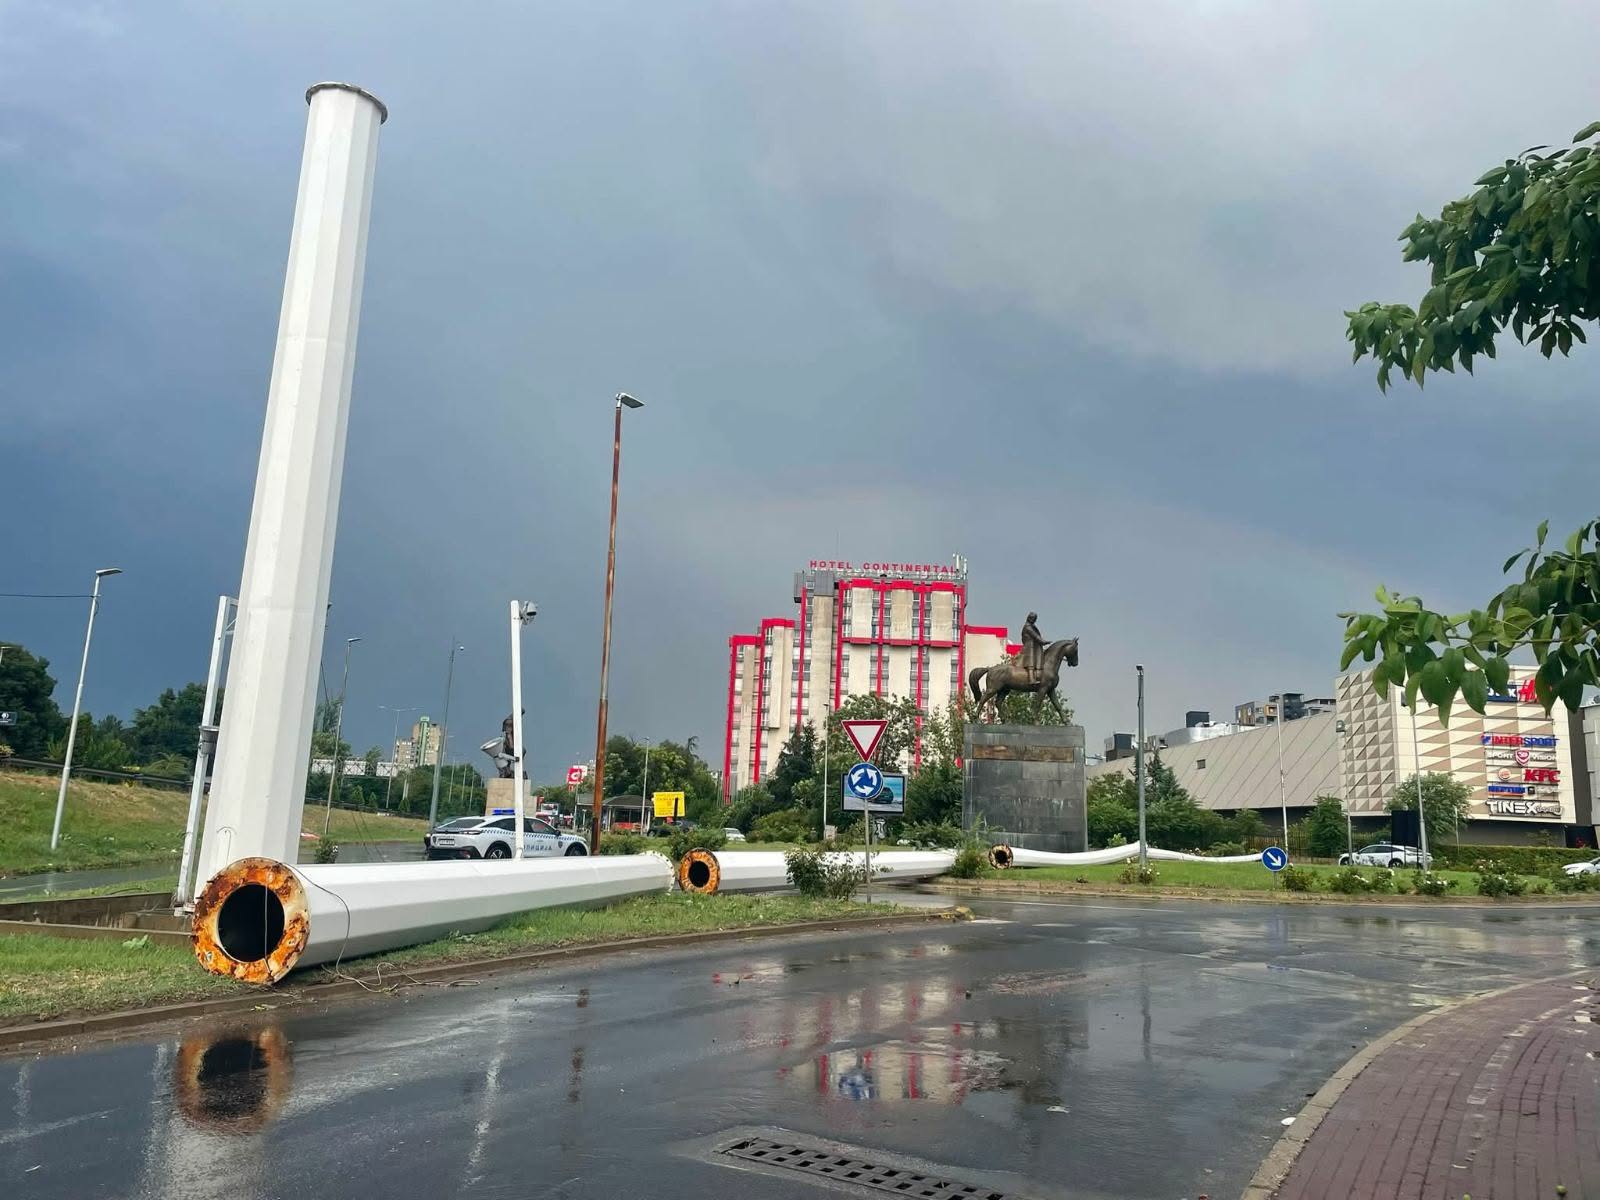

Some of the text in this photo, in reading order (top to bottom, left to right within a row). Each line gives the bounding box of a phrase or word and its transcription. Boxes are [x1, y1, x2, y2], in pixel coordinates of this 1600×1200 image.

[810, 560, 957, 574] HOTEL CONTINENTAL
[1493, 735, 1559, 747] INTERSPORT
[1487, 751, 1513, 759] SPORT
[1524, 768, 1561, 783] KFC
[1486, 800, 1538, 815] TINEX
